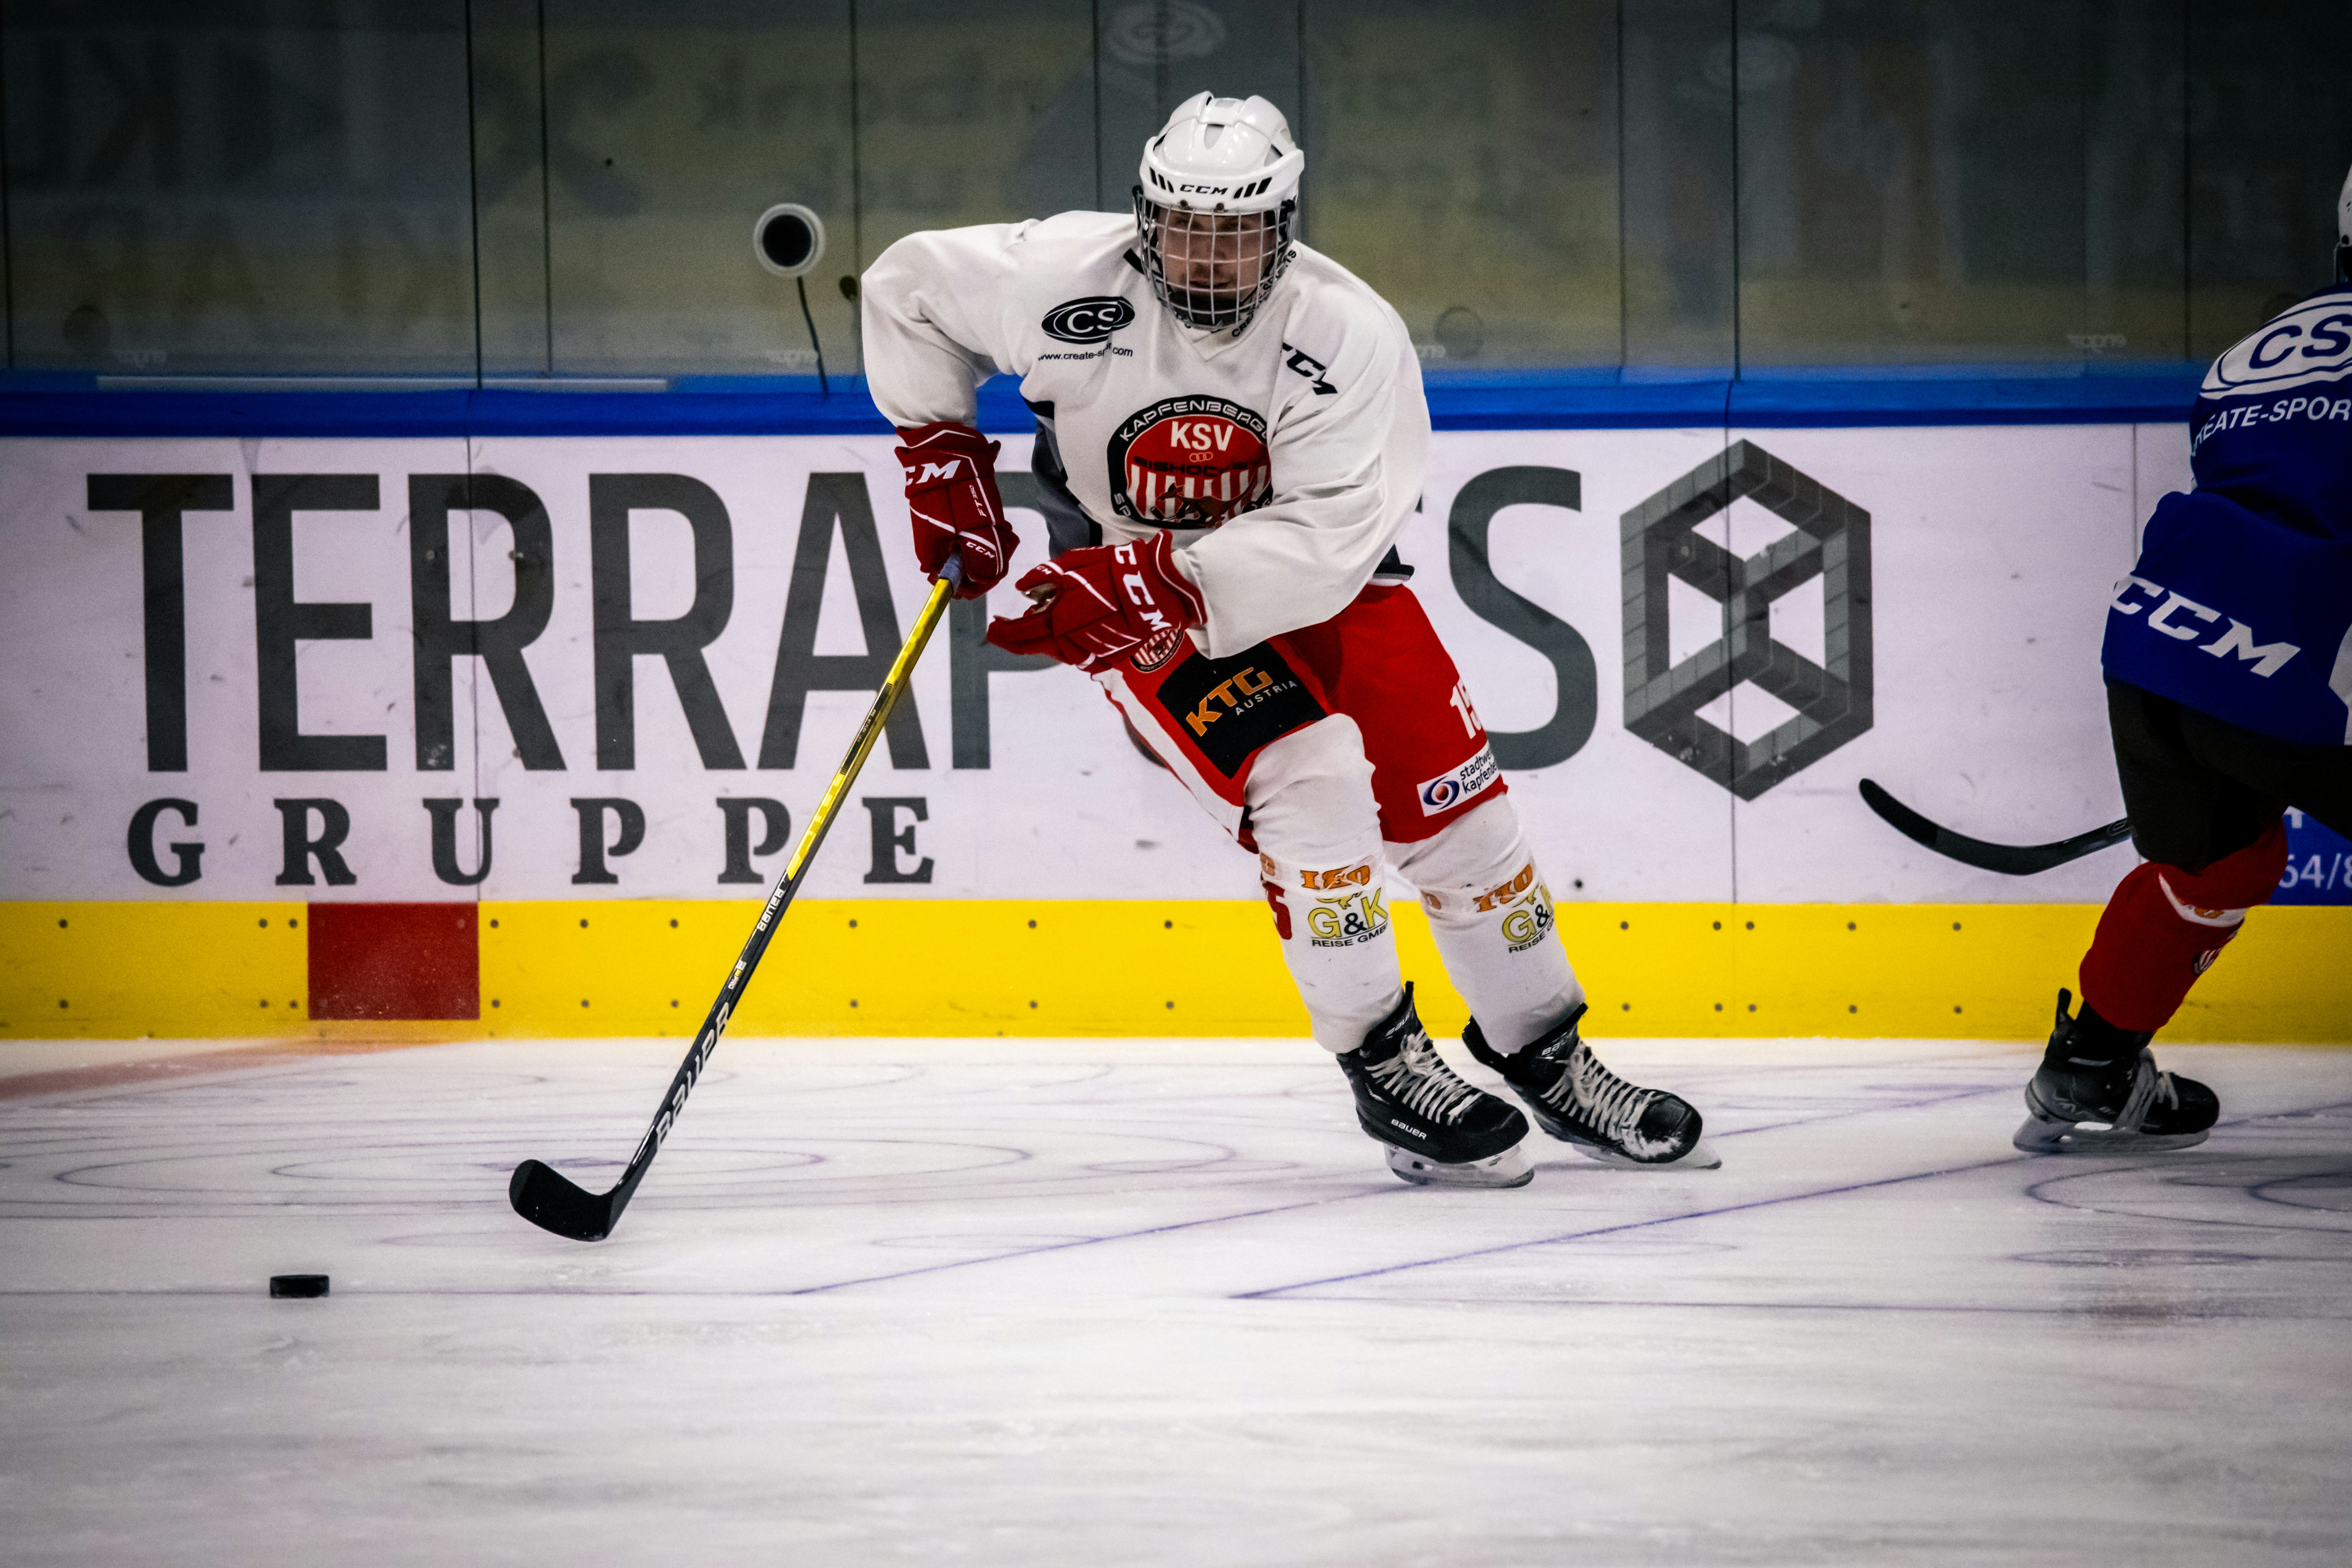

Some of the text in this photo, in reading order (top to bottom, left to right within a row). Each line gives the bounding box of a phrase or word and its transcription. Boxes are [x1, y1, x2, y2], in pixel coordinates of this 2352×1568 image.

[1180, 184, 1228, 195] CCM
[1067, 308, 1116, 333] CS
[2249, 313, 2352, 369] CS
[1171, 421, 1234, 452] KSV
[966, 541, 996, 559] CCM
[1114, 543, 1172, 632] CCM
[2111, 574, 2301, 678] CCM
[1186, 667, 1273, 737] KTG
[1235, 681, 1297, 716] AUSTRIA
[127, 797, 935, 886] GRUPPE
[1308, 887, 1388, 938] G&K
[1312, 938, 1354, 947] REISE
[1508, 931, 1545, 954] REISE
